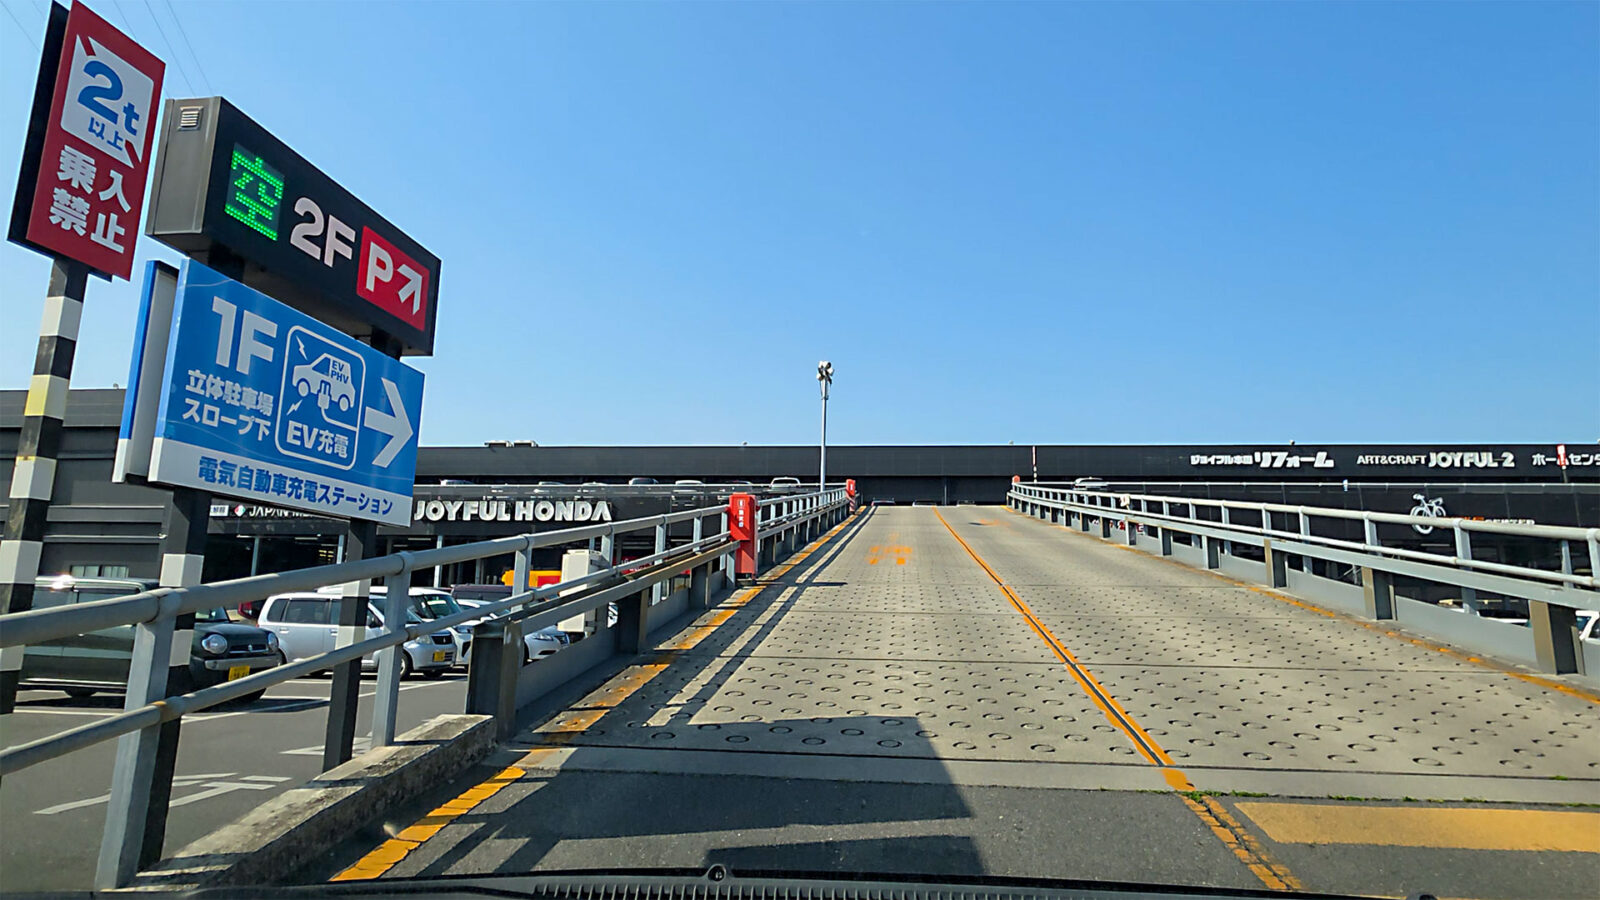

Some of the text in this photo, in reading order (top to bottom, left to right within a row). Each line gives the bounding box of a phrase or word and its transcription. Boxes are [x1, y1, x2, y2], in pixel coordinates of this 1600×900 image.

[78, 60, 139, 136] 2t
[88, 117, 125, 151] 以上
[57, 145, 131, 213] 乗入
[224, 150, 285, 241] 空
[49, 187, 125, 254] 禁止
[290, 197, 394, 293] 2F P
[212, 296, 278, 374] 1F
[331, 370, 349, 384] PHV
[332, 360, 345, 372] EV
[185, 369, 274, 417] 立体駐車場
[182, 398, 271, 441] スロープ下
[286, 420, 349, 459] EV充電
[1254, 451, 1335, 468] リフォーム
[1356, 454, 1427, 465] ART&CRAFT
[198, 456, 393, 516] 電気自動車充電ステーション
[414, 500, 612, 521] JOYFUL HONDA
